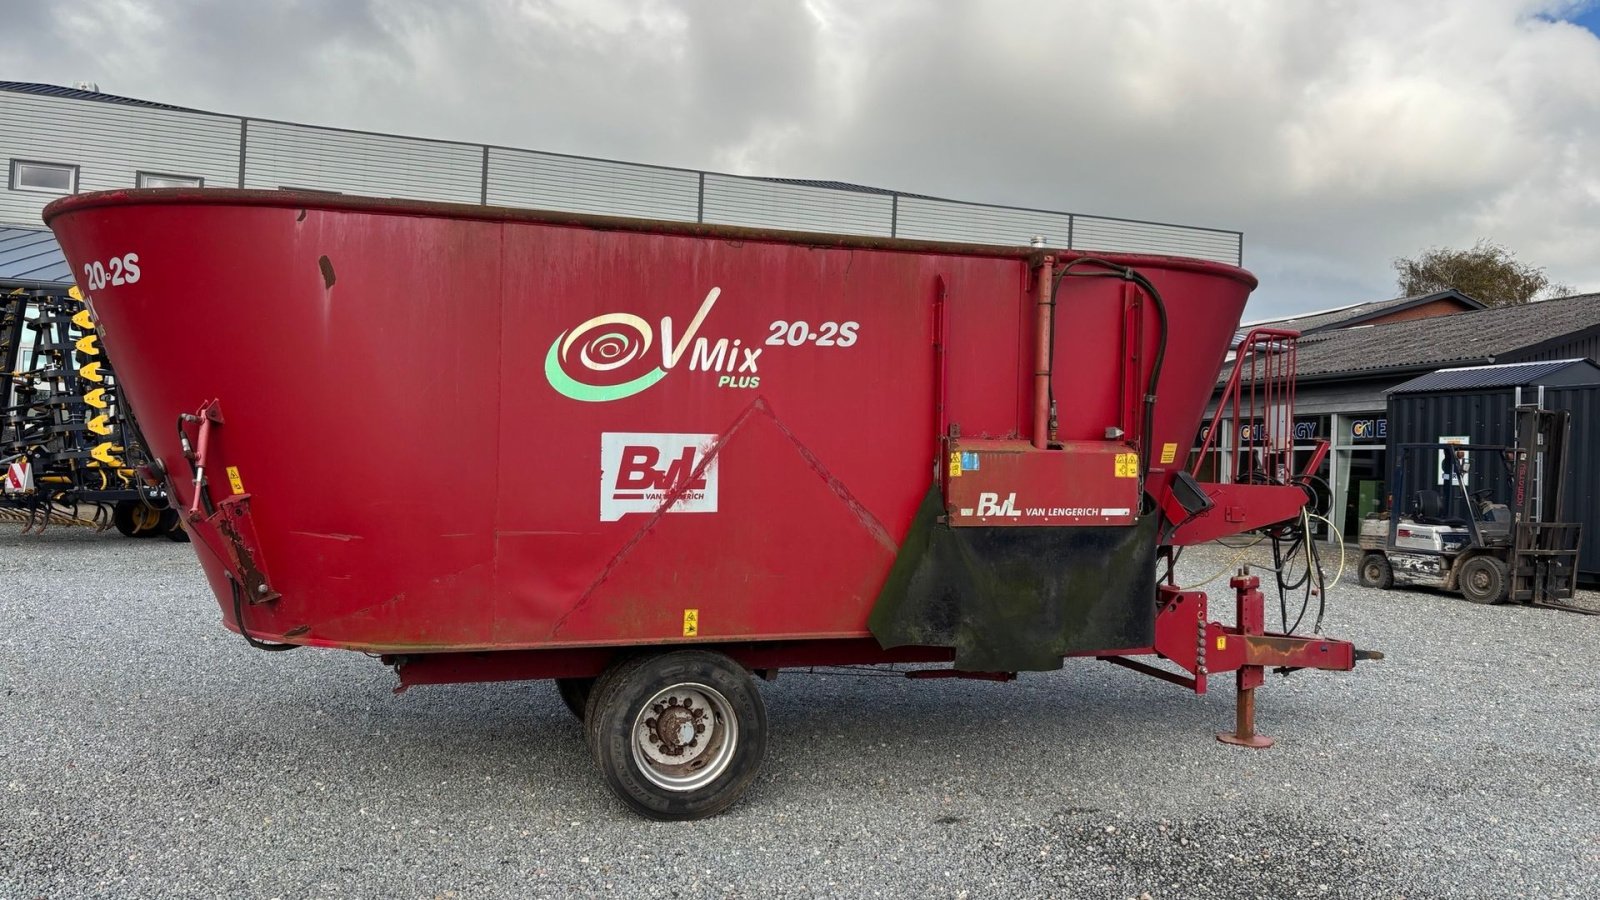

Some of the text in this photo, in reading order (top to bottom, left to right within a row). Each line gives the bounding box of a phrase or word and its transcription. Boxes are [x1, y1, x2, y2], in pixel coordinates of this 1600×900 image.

[765, 320, 861, 348] 20-2S
[717, 375, 761, 390] PLUS
[1025, 508, 1046, 517] VAN
[1048, 508, 1099, 517] LENGERICH
